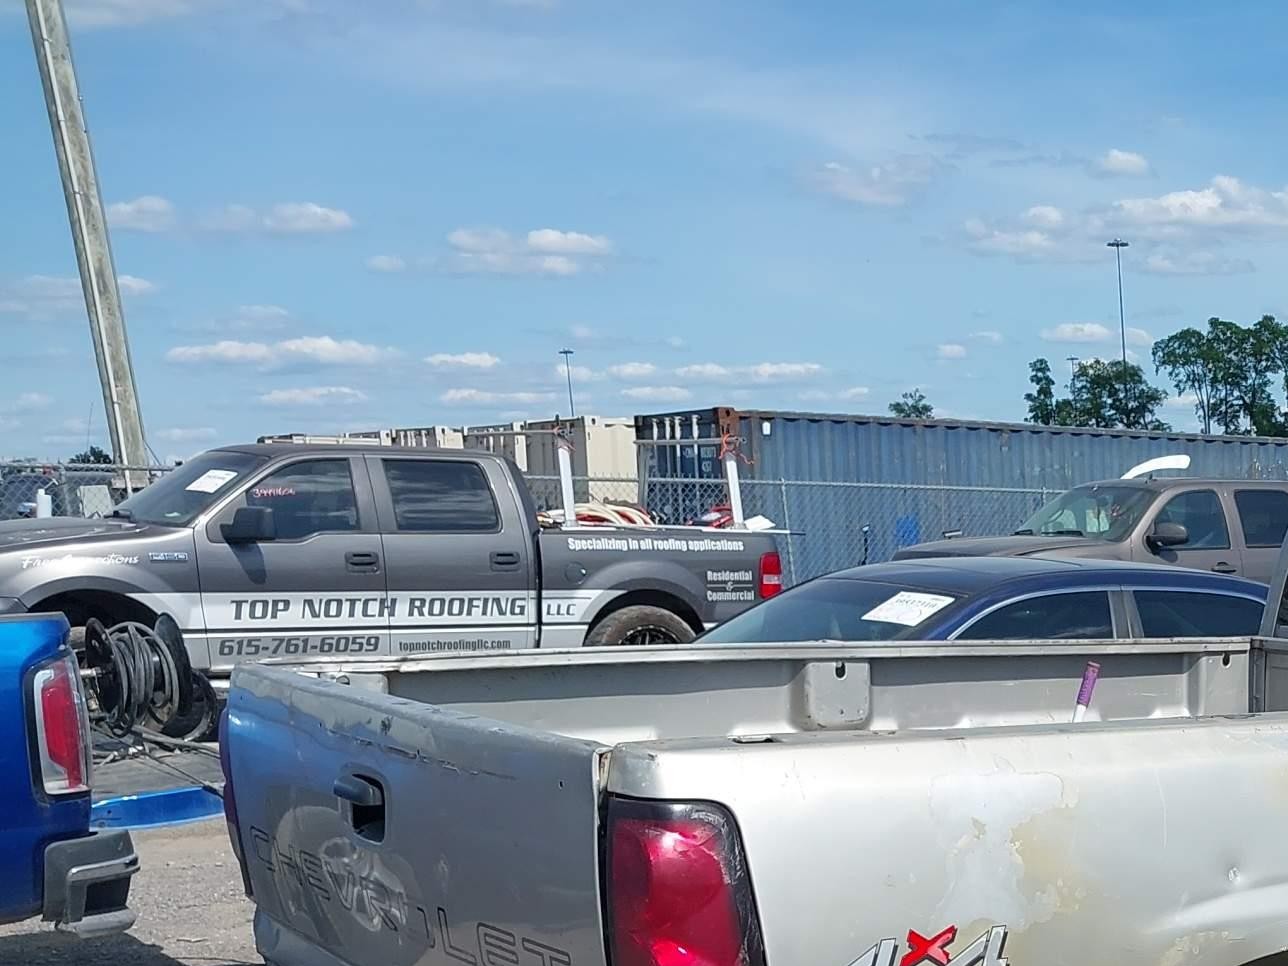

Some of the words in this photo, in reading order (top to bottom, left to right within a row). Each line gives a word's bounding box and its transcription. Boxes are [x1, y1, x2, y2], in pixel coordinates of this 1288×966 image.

[568, 537, 627, 550] Specializing
[629, 538, 638, 550] in
[640, 539, 652, 550] all
[654, 539, 687, 551] roofing
[689, 539, 744, 551] applications
[707, 571, 753, 581] Residential
[707, 591, 755, 601] Commercial
[230, 599, 291, 620] TOP
[302, 598, 397, 619] NOTCH
[408, 597, 527, 617] ROOFING
[546, 603, 576, 616] LLC
[219, 636, 380, 656] 615-761-6059
[399, 639, 511, 652] topnotchroofingllc.com
